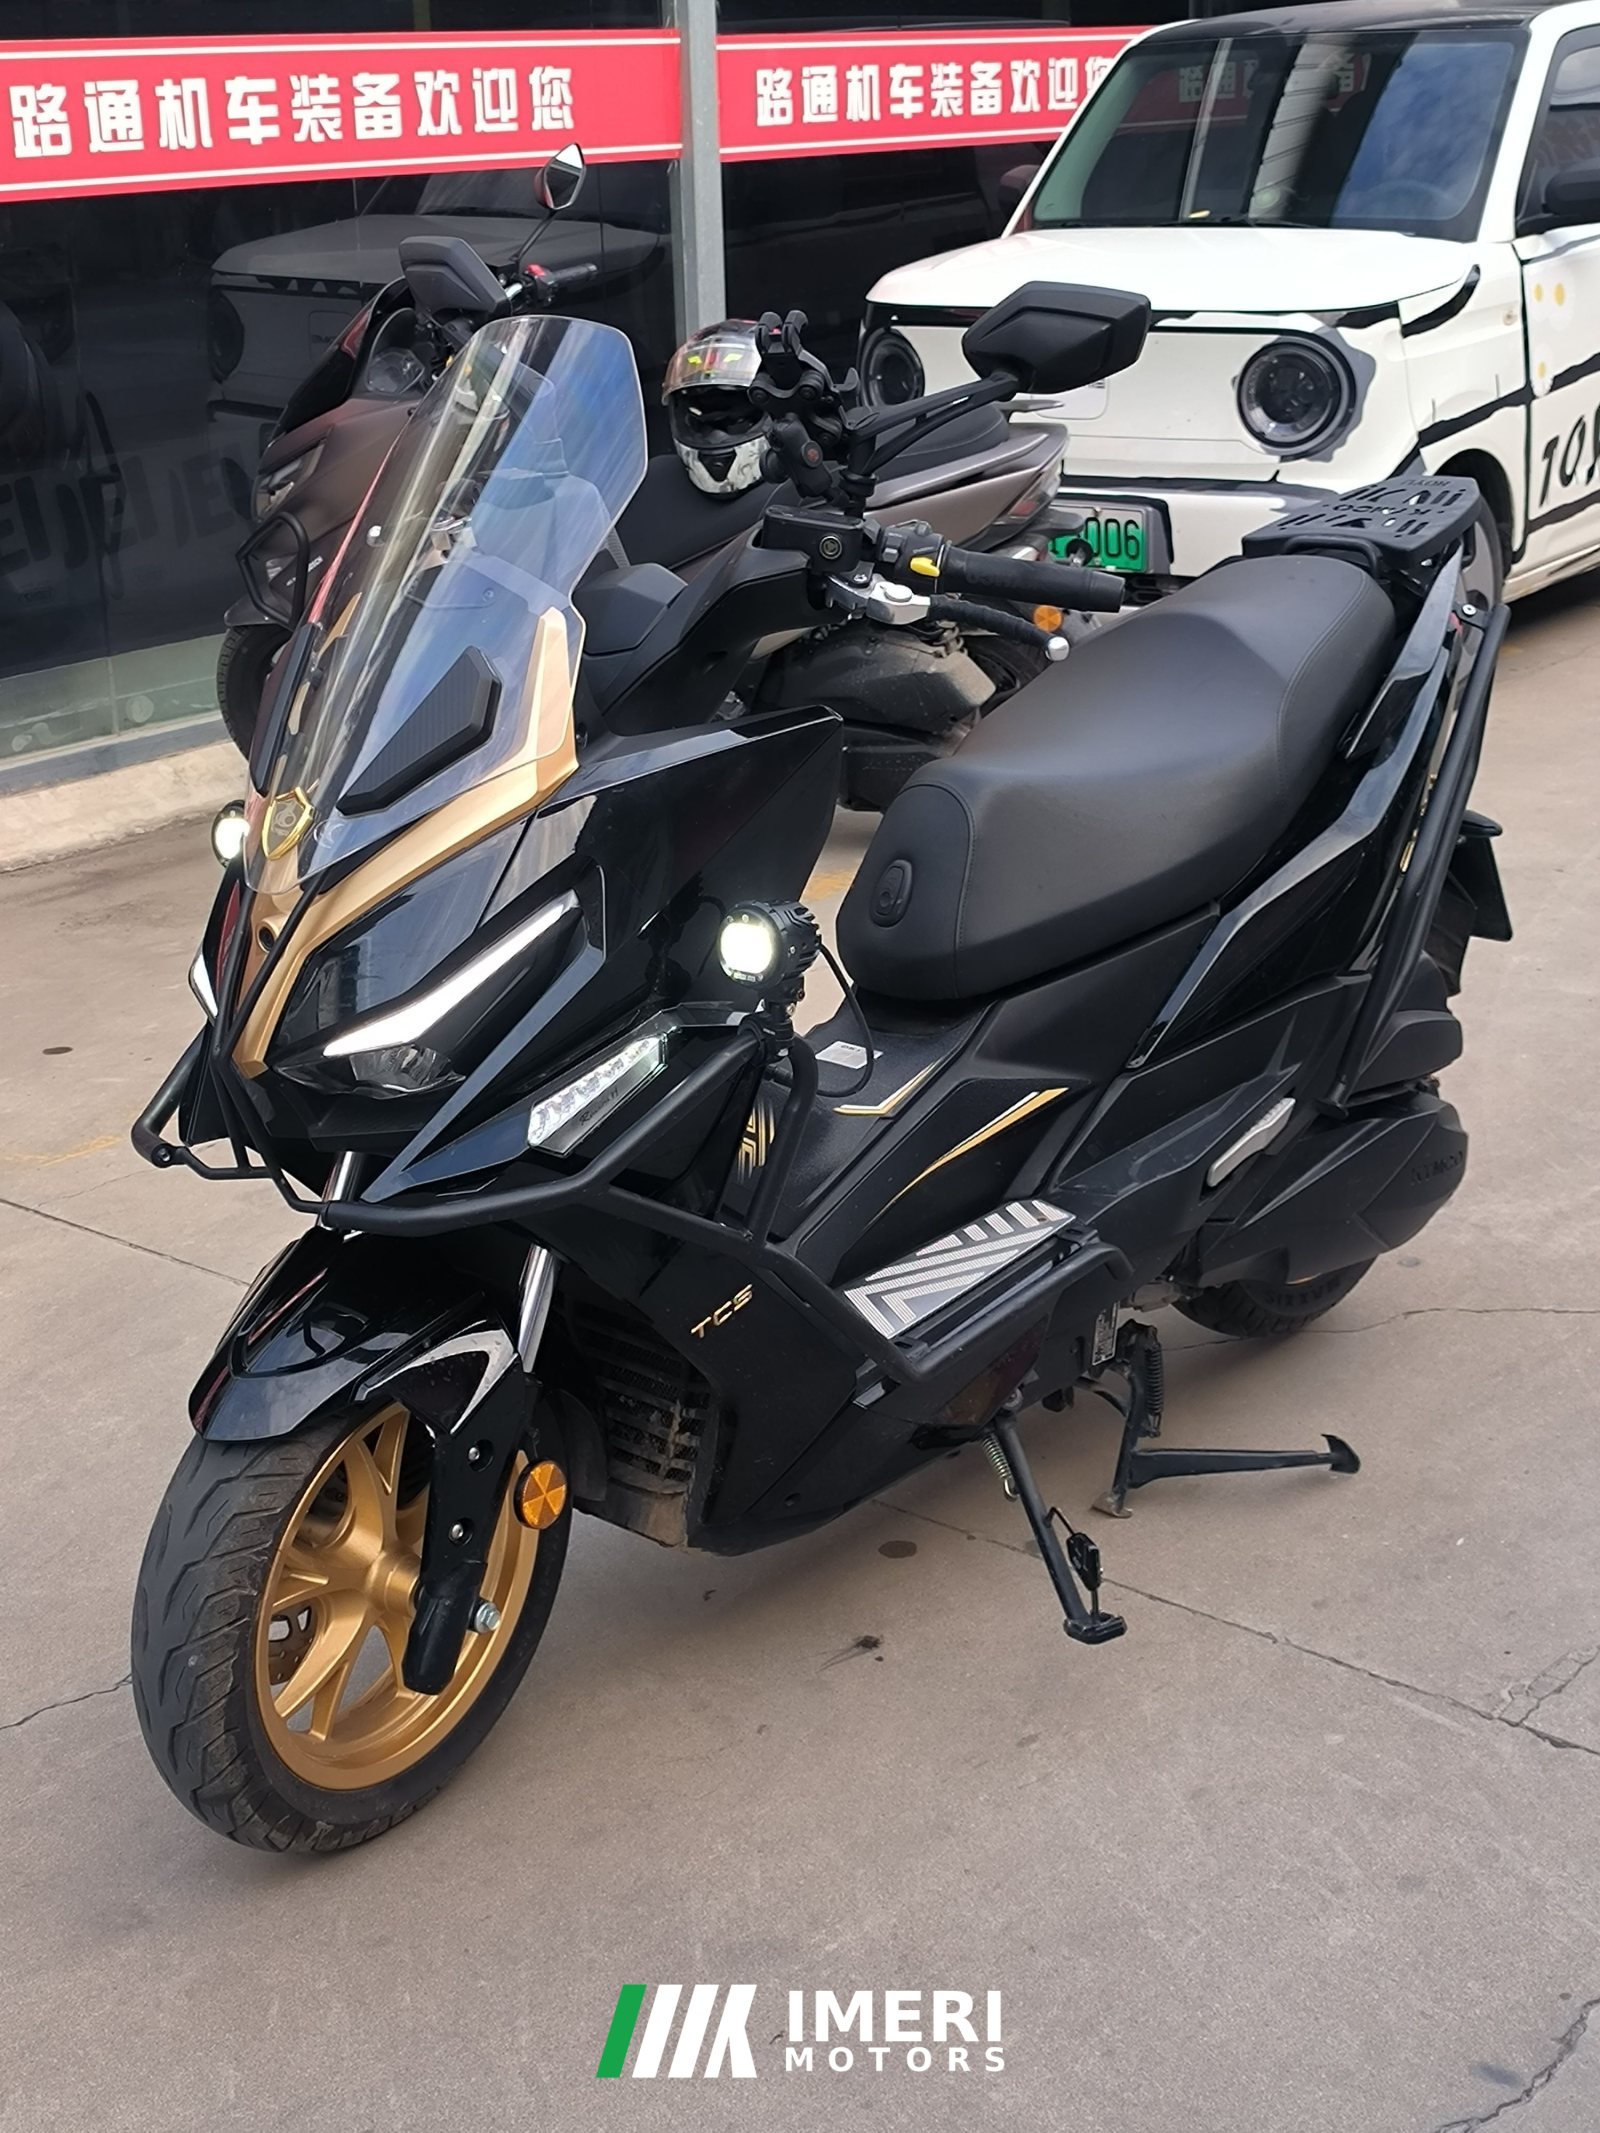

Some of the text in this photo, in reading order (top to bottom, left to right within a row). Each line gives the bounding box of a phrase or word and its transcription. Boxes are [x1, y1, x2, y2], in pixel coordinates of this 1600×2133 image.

[9, 66, 574, 159] 路通机车装备欢迎您
[690, 1284, 753, 1338] TCS
